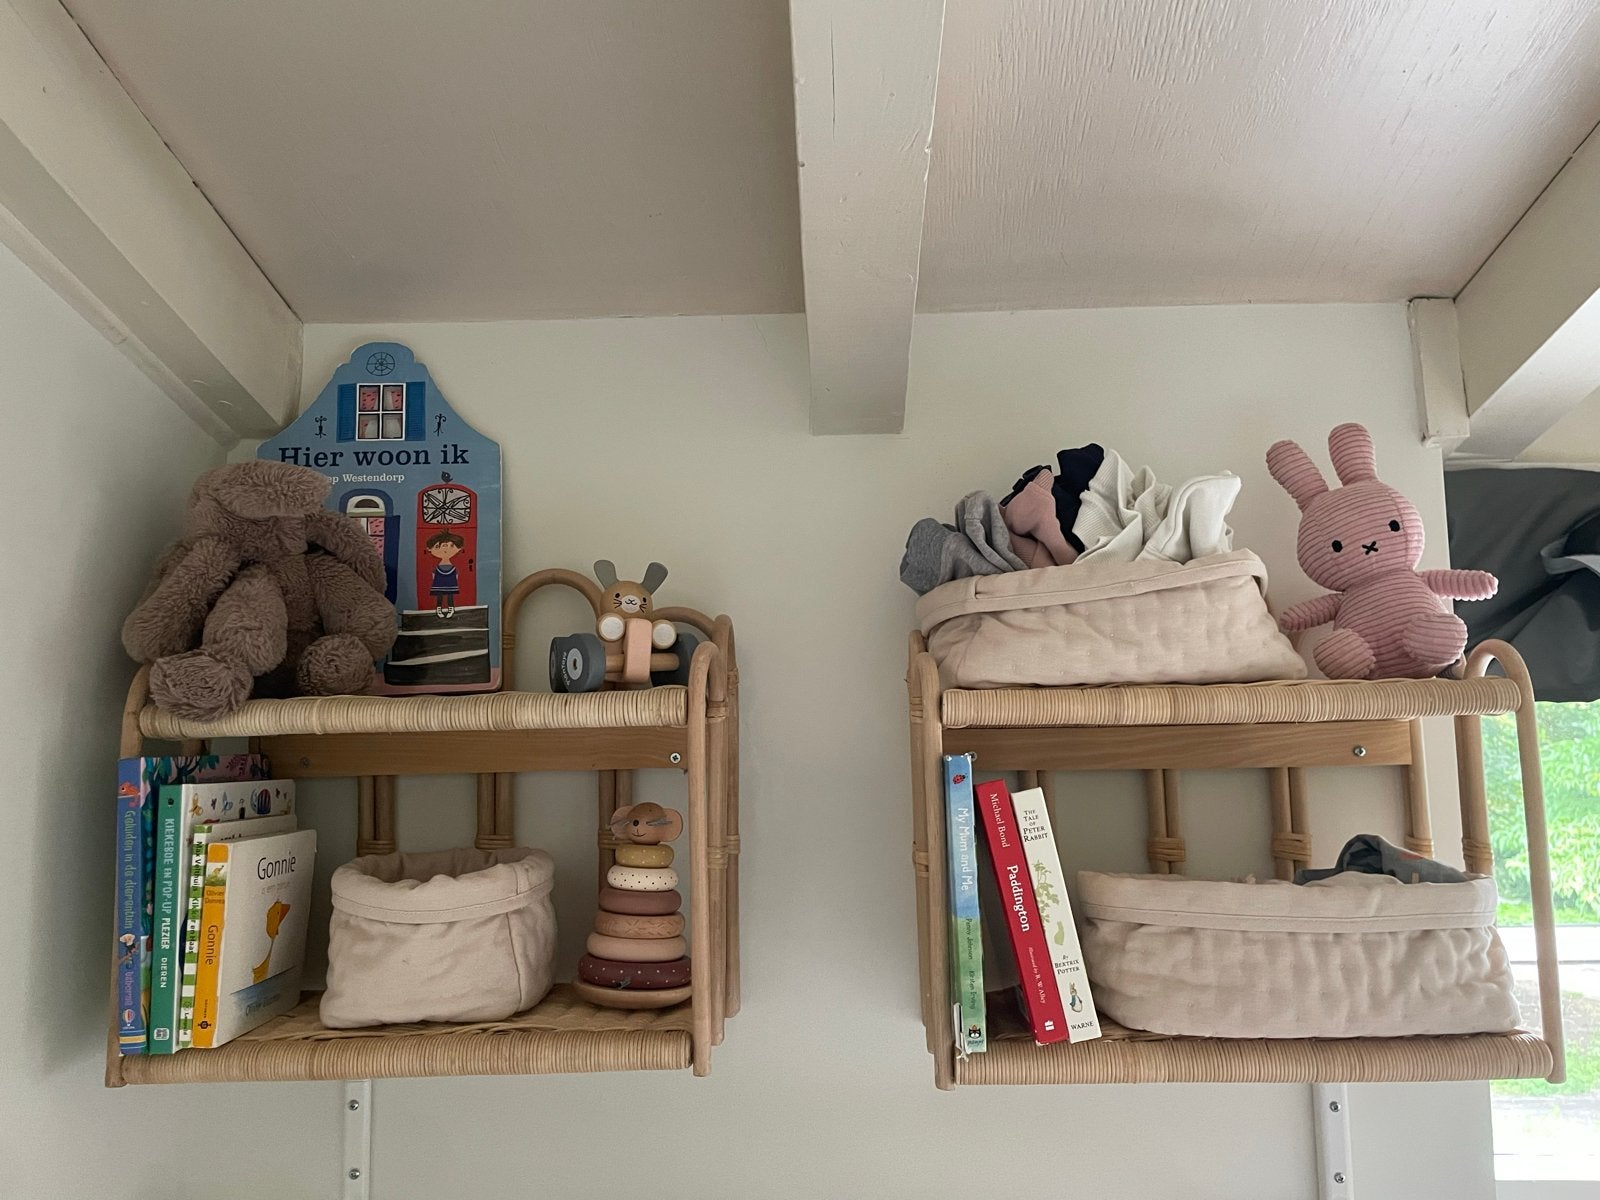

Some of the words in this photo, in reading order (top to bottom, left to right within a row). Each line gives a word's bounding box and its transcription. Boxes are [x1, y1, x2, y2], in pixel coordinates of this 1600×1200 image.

[278, 446, 344, 468] Hier
[353, 449, 431, 466] woon
[440, 444, 470, 465] ik
[342, 473, 405, 483] Westendorp
[956, 807, 969, 821] My
[990, 793, 1002, 827] Michael
[998, 826, 1010, 848] Bond
[124, 810, 137, 851] Geluiden
[960, 826, 970, 854] Mum
[1023, 825, 1045, 834] PETER
[1023, 832, 1048, 842] RABBIT
[124, 853, 134, 862] in
[257, 850, 296, 880] Gonnie
[961, 854, 972, 872] and
[961, 875, 973, 891] Me
[162, 880, 173, 914] POP-UP
[1007, 864, 1030, 932] Paddington
[161, 917, 171, 950] PLEZIER
[205, 924, 219, 965] Gonnie
[160, 957, 168, 988] DIEREN
[1054, 959, 1080, 969] BEATRIX
[1057, 966, 1080, 975] POTTER
[1070, 1021, 1094, 1030] WARNE
